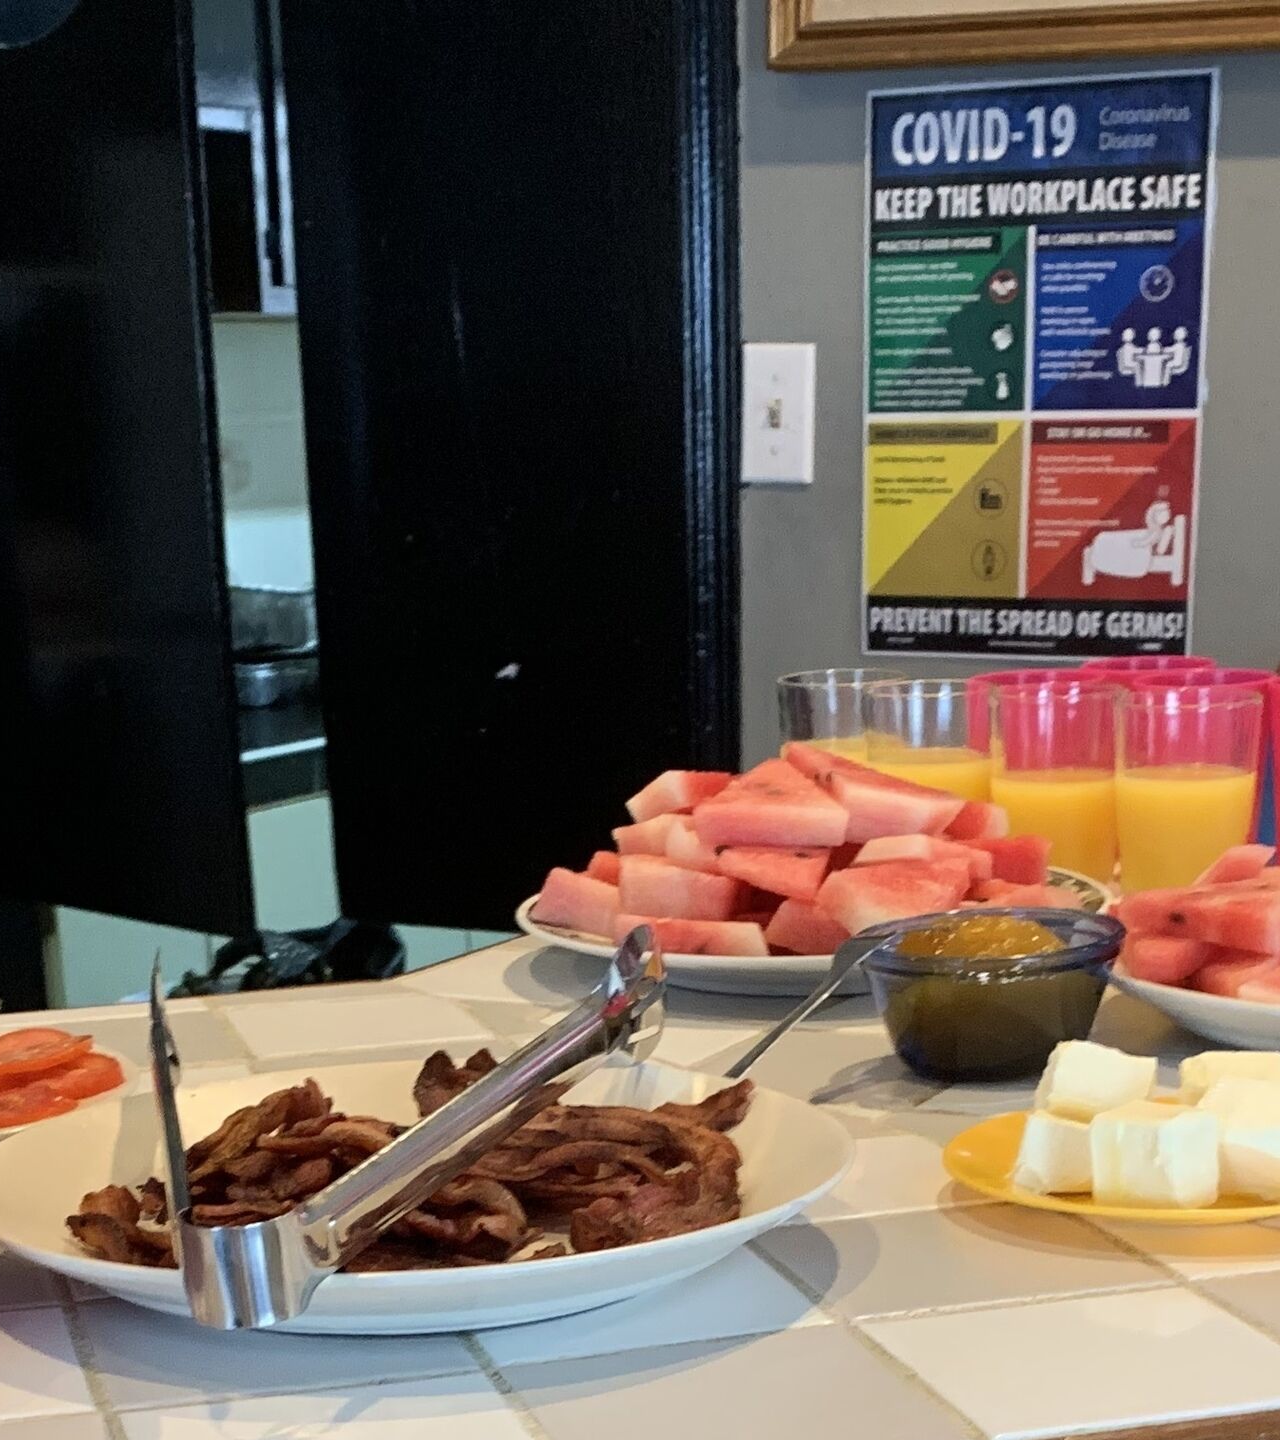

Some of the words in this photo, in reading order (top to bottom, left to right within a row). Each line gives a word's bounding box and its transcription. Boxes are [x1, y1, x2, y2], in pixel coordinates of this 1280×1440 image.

[1098, 103, 1192, 127] Coronavirus
[891, 103, 1078, 166] COVID-19
[1098, 131, 1158, 151] Disease
[874, 186, 933, 222] KEEP
[936, 184, 983, 219] THE
[987, 176, 1137, 216] WORKPLACE
[1139, 173, 1202, 209] SAFE
[869, 606, 954, 634] PREVENT
[956, 607, 995, 635] THE
[996, 608, 1074, 637] SPREAD
[1075, 609, 1104, 638] OF
[1105, 611, 1185, 640] GERMS!
